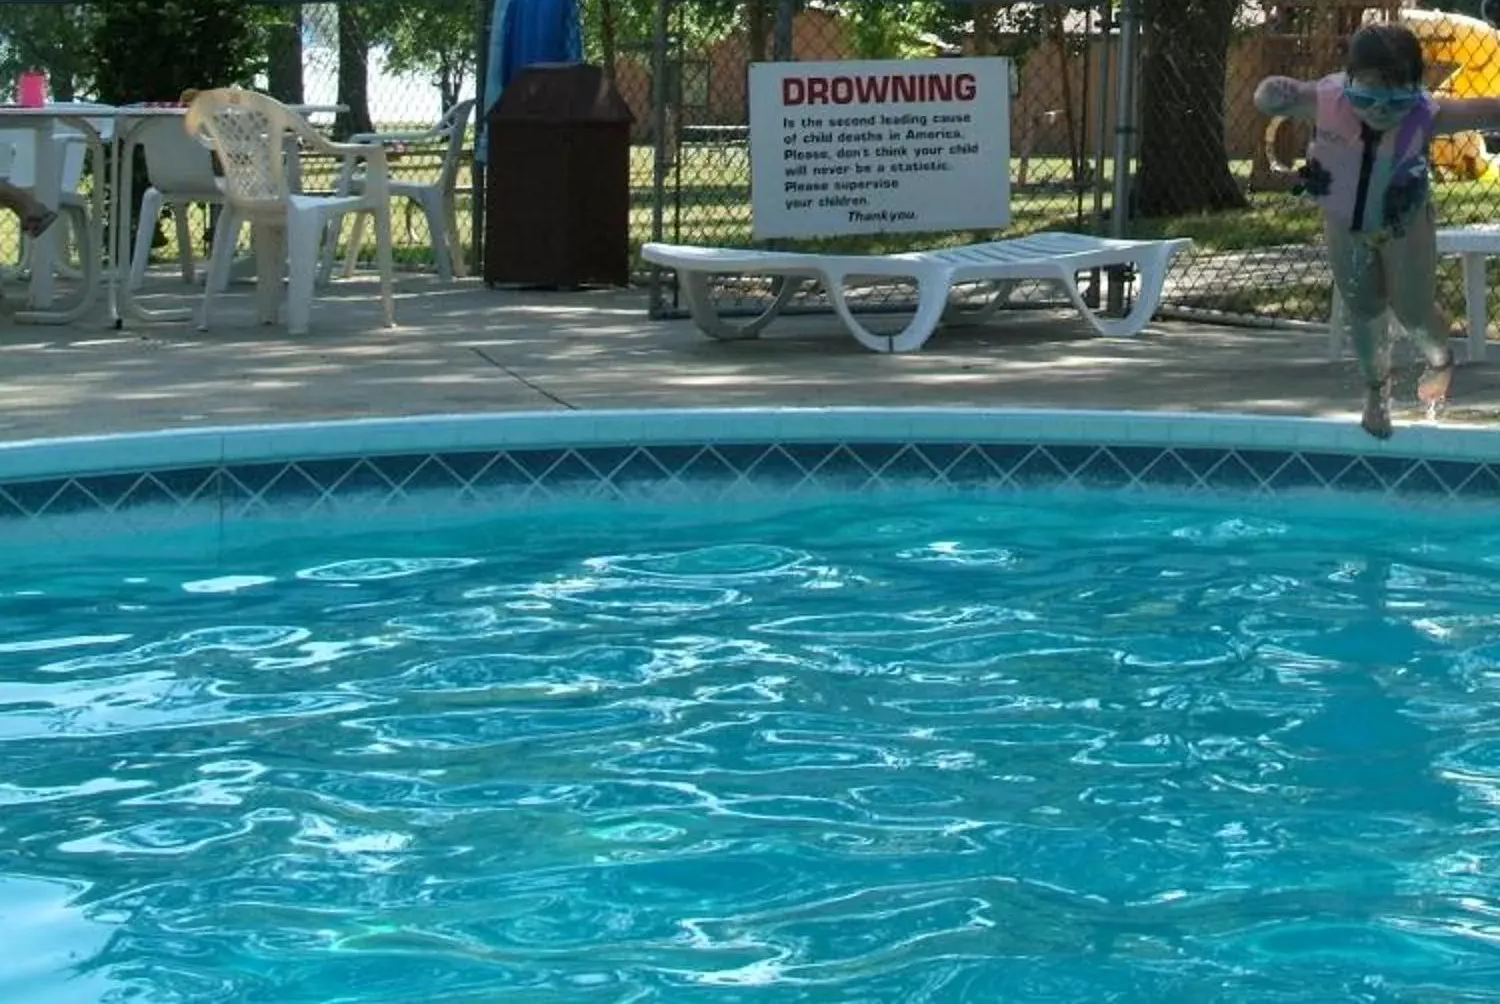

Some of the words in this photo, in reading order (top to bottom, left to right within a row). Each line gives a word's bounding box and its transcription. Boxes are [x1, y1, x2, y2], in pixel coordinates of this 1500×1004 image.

[782, 73, 978, 107] DROWNING
[783, 117, 795, 129] Is
[801, 116, 823, 128] the
[828, 115, 875, 127] second
[880, 113, 927, 127] leading
[932, 113, 972, 123] cause
[783, 132, 797, 145] of
[803, 131, 833, 143] child
[837, 129, 883, 142] deaths
[889, 129, 901, 141] in
[836, 146, 871, 158] don't
[875, 144, 907, 157] think
[913, 144, 944, 157] your
[948, 141, 979, 155] child
[785, 164, 807, 177] will
[813, 163, 850, 175] never
[855, 161, 871, 173] be
[877, 163, 885, 173] a
[784, 180, 829, 193] Please
[834, 178, 899, 191] supervise
[785, 197, 813, 211] your
[848, 211, 888, 223] Thank
